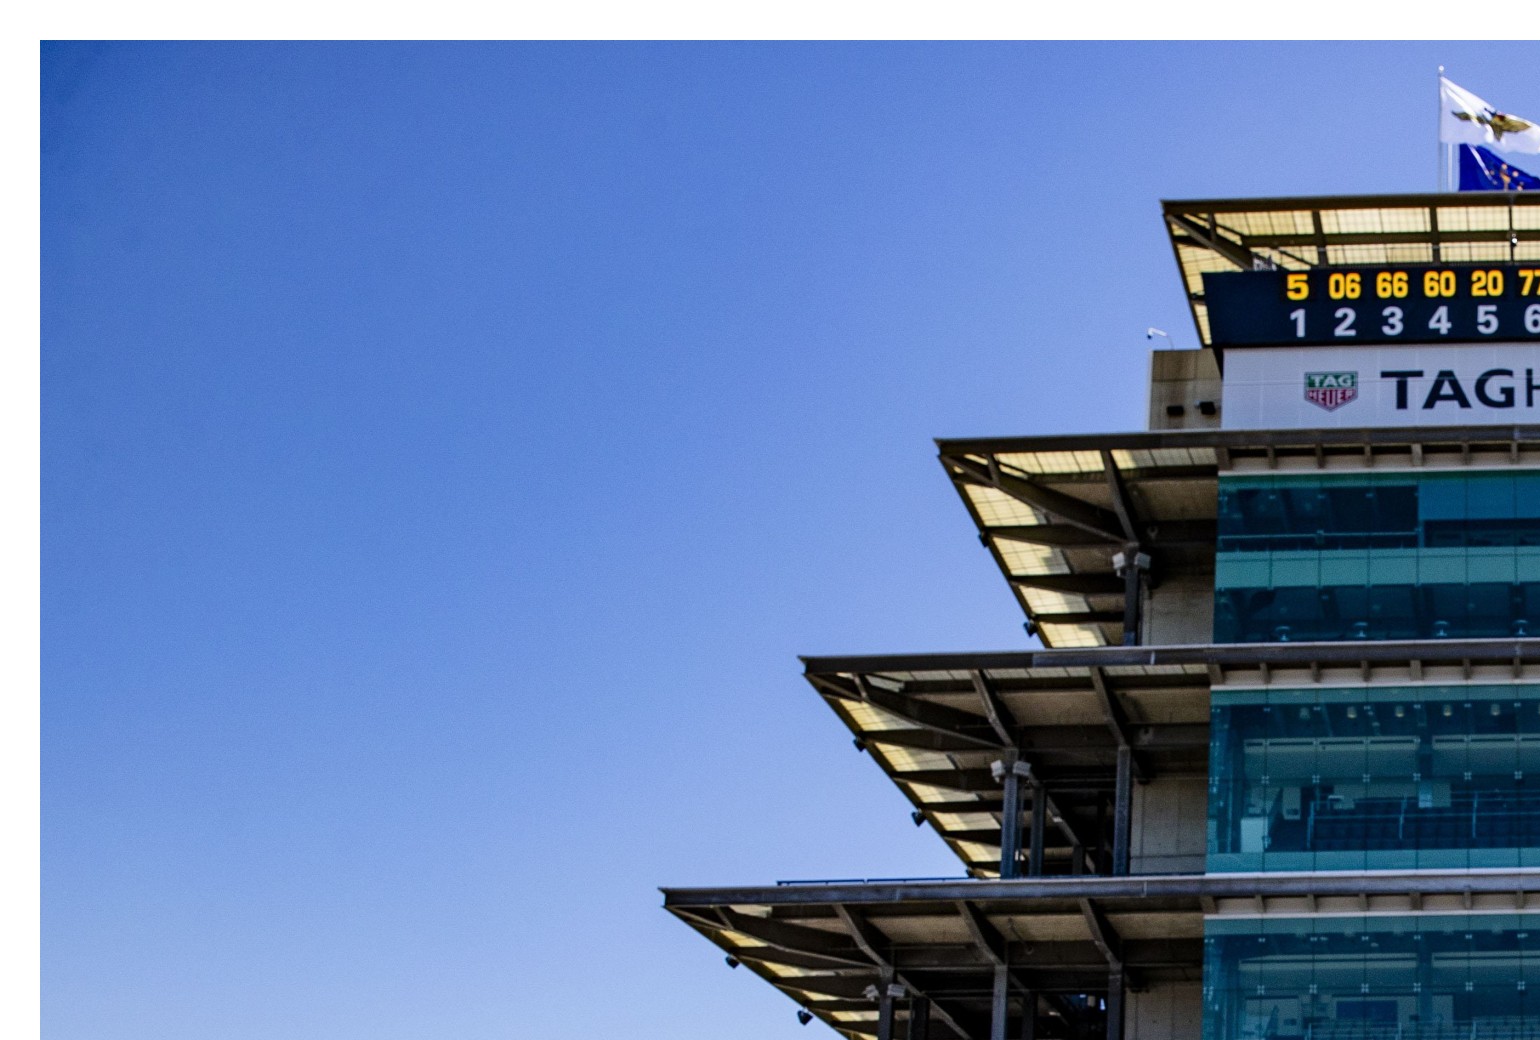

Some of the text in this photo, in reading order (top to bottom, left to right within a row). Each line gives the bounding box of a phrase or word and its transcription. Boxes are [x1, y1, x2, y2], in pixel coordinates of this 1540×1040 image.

[1286, 273, 1309, 300] 5
[1328, 273, 1361, 299] 06
[1376, 271, 1408, 298] 66
[1423, 270, 1456, 297] 60
[1471, 270, 1504, 297] 20
[1290, 308, 1306, 338] 1
[1334, 307, 1357, 336] 2
[1381, 306, 1404, 336] 3
[1428, 305, 1452, 335] 4
[1476, 305, 1499, 334] 5
[1311, 375, 1352, 387] TAG
[1307, 388, 1355, 406] HEUER
